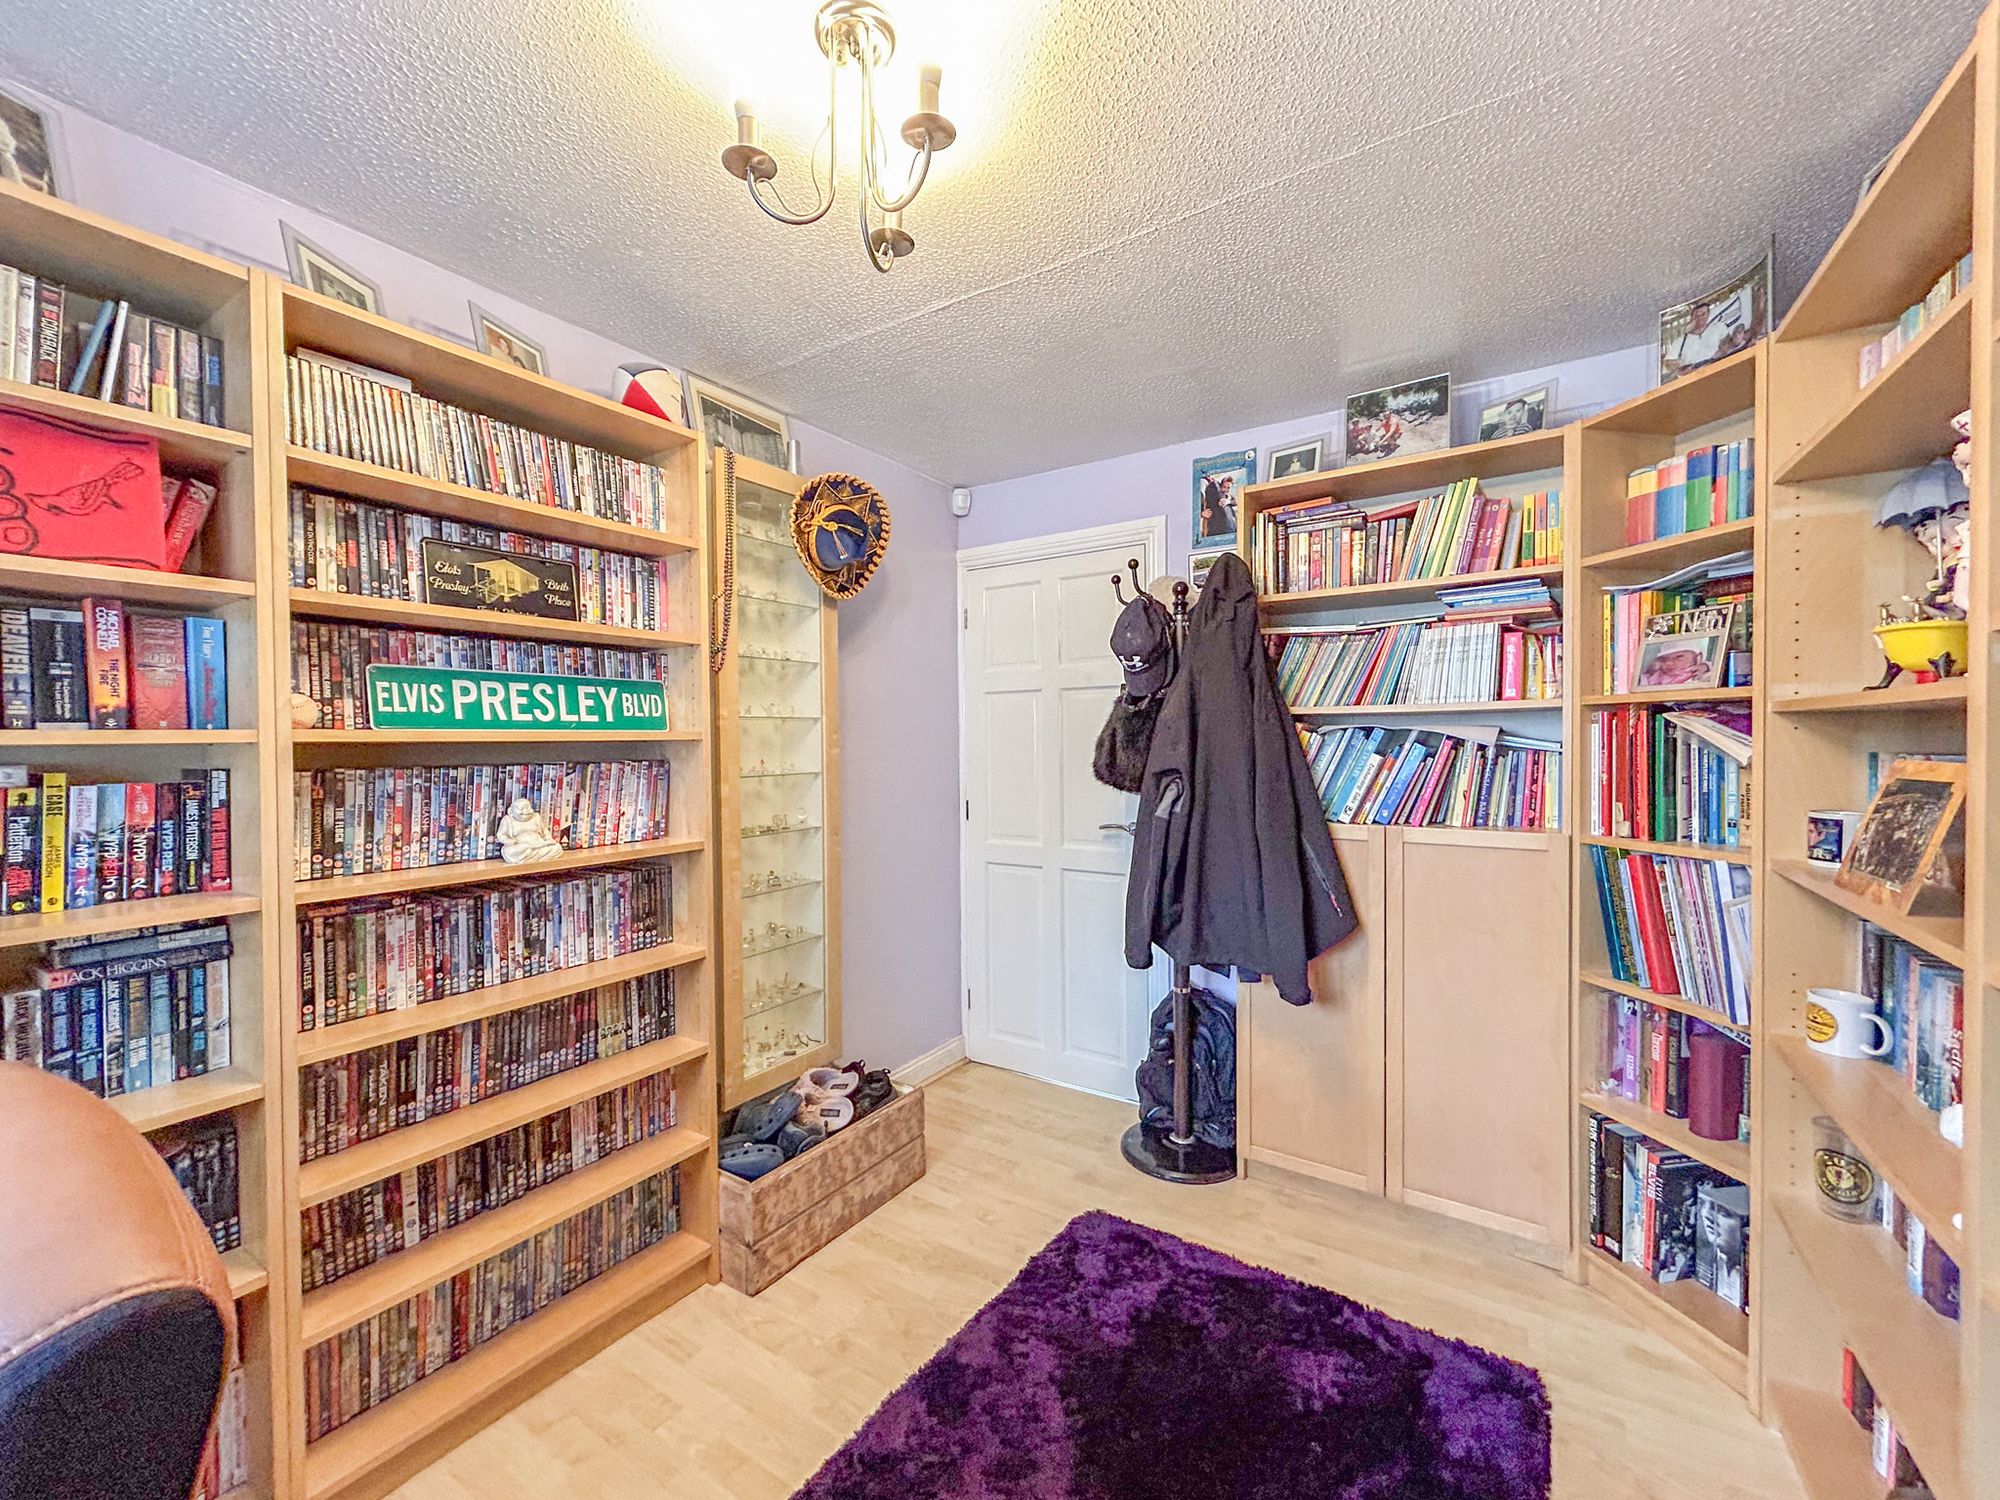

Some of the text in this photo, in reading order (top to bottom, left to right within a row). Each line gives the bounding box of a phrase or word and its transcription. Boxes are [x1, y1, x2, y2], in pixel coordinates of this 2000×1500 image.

[39, 316, 59, 363] COMEBACK
[1, 614, 29, 675] DEAVER
[96, 607, 121, 652] MICHAEL CONNELLY
[99, 658, 120, 698] THE NIGHT FIRE
[375, 678, 662, 722] ELVIS PRESLEY BLVD
[46, 794, 63, 818] CASE
[186, 799, 199, 820] JAMES
[421, 799, 431, 829] CRASH
[7, 816, 32, 862] Patterson
[104, 835, 121, 859] NYPD
[132, 834, 147, 862] NYPD
[162, 820, 174, 849] NYPD
[185, 820, 199, 860] PATTERSON
[45, 836, 54, 878] PATTERSON
[53, 846, 62, 869] JAMES
[75, 844, 89, 869] NYPD
[105, 858, 118, 877] RED
[407, 930, 416, 968] RAMBO
[63, 956, 167, 984] JACK HIGGINS
[303, 952, 313, 990] LIMITLESS
[53, 991, 68, 1014] JACK
[81, 987, 98, 1050] JACK HIGGINS
[106, 980, 121, 1032] JACK HIGGINS
[15, 995, 30, 1061] JACK HIGGINS
[379, 1060, 388, 1106] TAKEN
[1589, 1118, 1599, 1142] ELVIS
[1647, 1162, 1657, 1199] ELVIS
